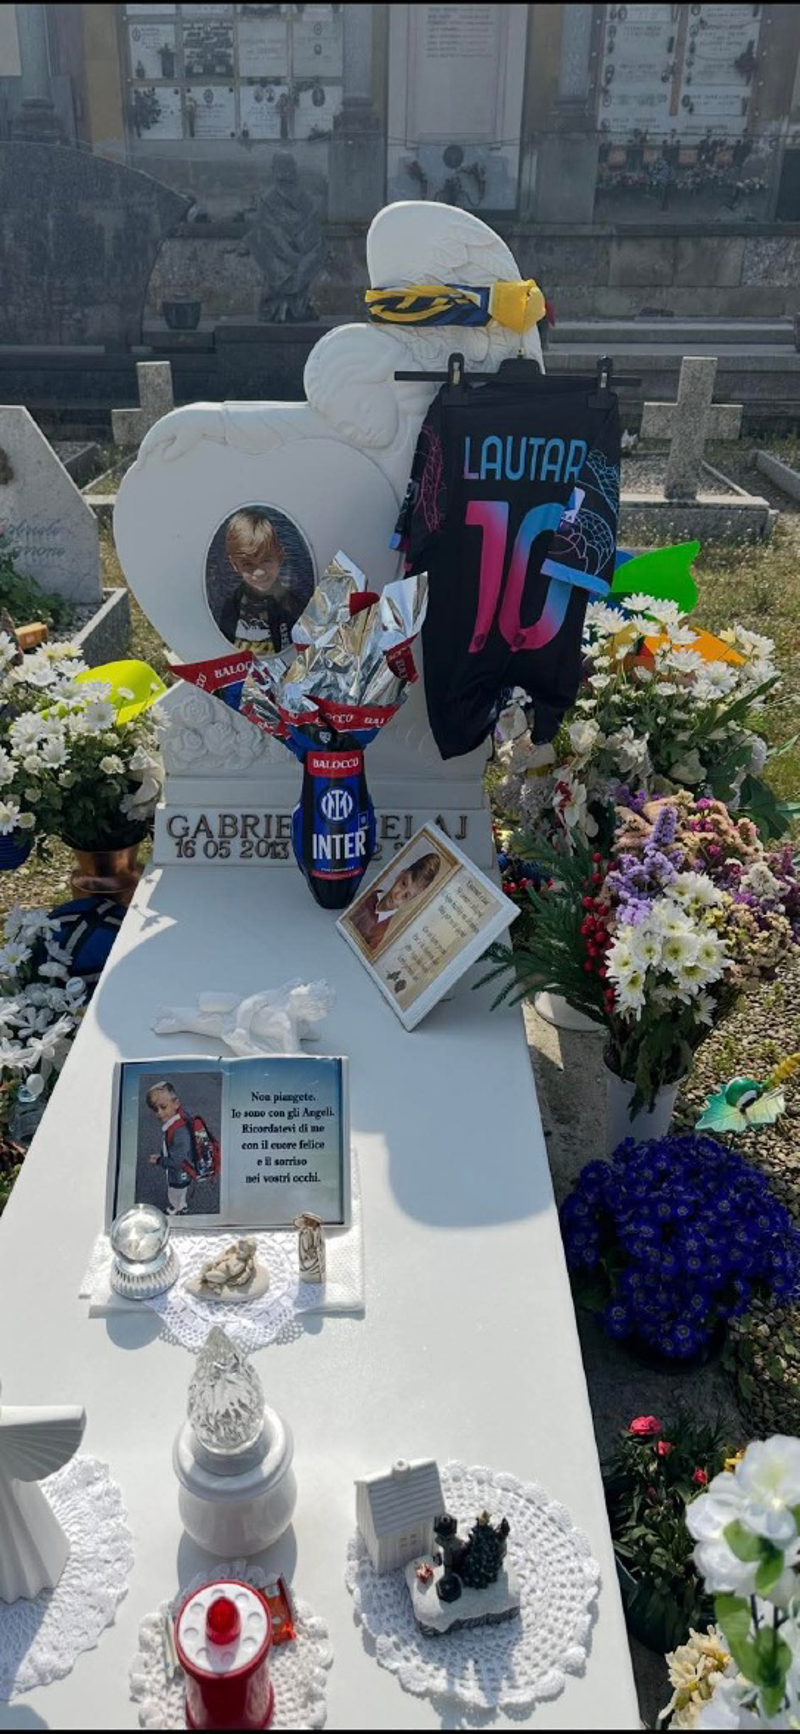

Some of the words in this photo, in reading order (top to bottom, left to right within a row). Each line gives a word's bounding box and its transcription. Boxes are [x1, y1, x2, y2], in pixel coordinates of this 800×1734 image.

[464, 435, 588, 483] LAUTAR
[465, 500, 575, 653] 10
[313, 757, 359, 768] BALOCCO
[176, 839, 196, 858] 16
[203, 840, 231, 859] 05
[312, 830, 366, 860] INTER
[251, 1091, 271, 1102] Non
[273, 1091, 316, 1104] piangete.
[231, 1108, 242, 1118] Io
[244, 1110, 266, 1118] sono
[268, 1110, 285, 1118] con
[287, 1107, 300, 1120] gli
[302, 1107, 336, 1119] Angeli.
[242, 1123, 297, 1133] Ricordatevi
[298, 1123, 308, 1133] di
[241, 1142, 259, 1150] con
[261, 1140, 268, 1150] il
[270, 1142, 297, 1150] cuore
[299, 1139, 325, 1150] felice
[265, 1156, 272, 1166] il
[274, 1156, 307, 1166] sorriso
[245, 1173, 261, 1183] nei
[263, 1172, 291, 1183] vostri
[293, 1172, 321, 1183] occhi.
